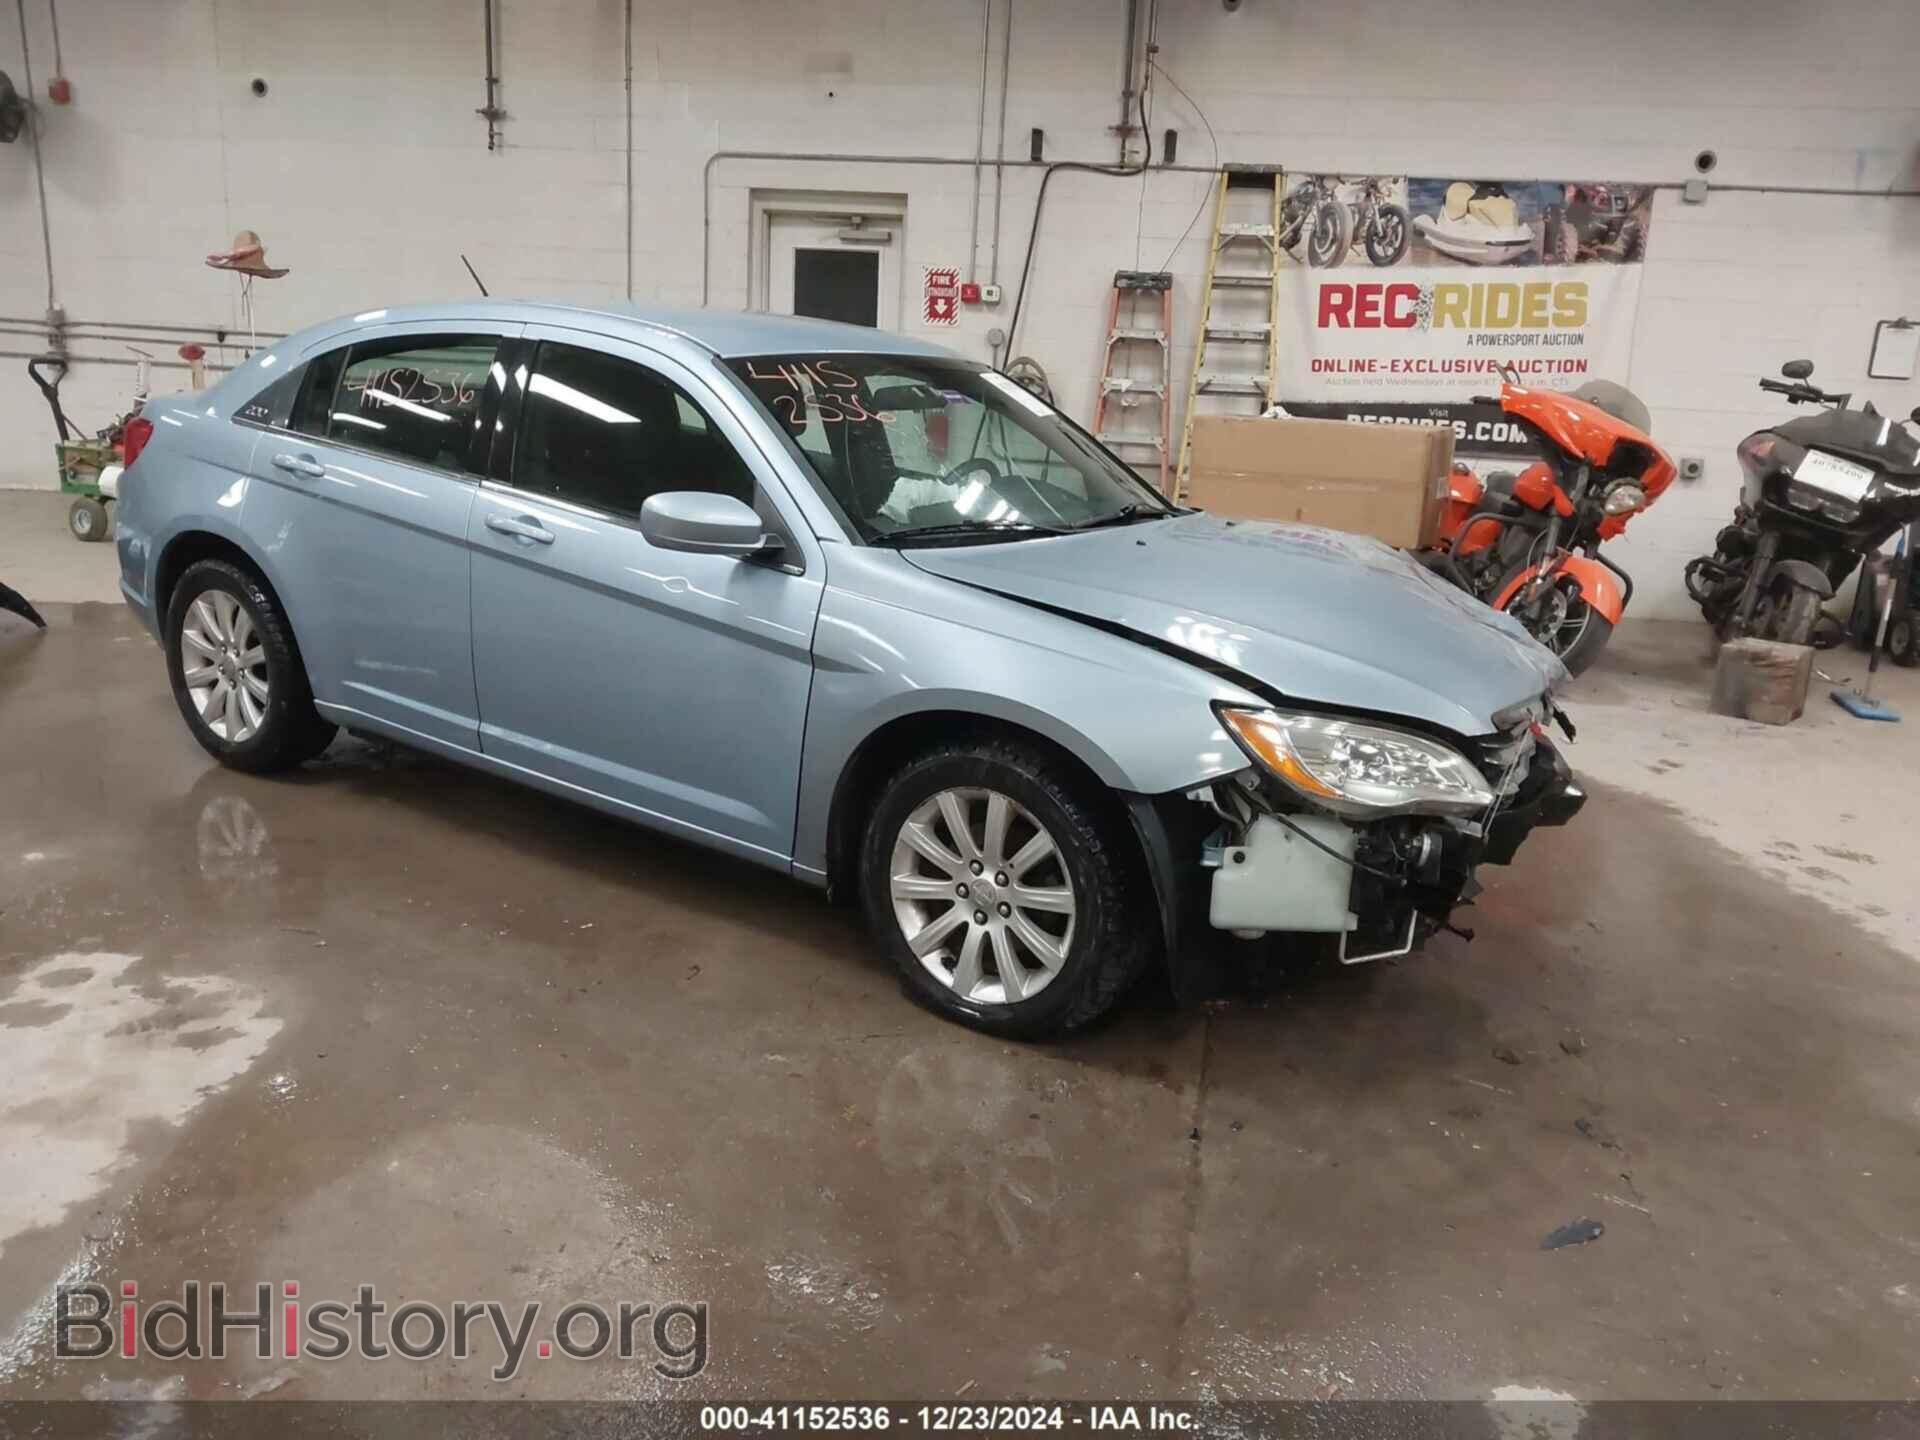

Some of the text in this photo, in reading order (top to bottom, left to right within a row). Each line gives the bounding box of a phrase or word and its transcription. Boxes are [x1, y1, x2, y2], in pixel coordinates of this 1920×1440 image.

[1318, 283, 1588, 328] REC RIDES
[1467, 333, 1584, 346] A POWERSPORT AUCTION
[1429, 408, 1449, 417] Visit
